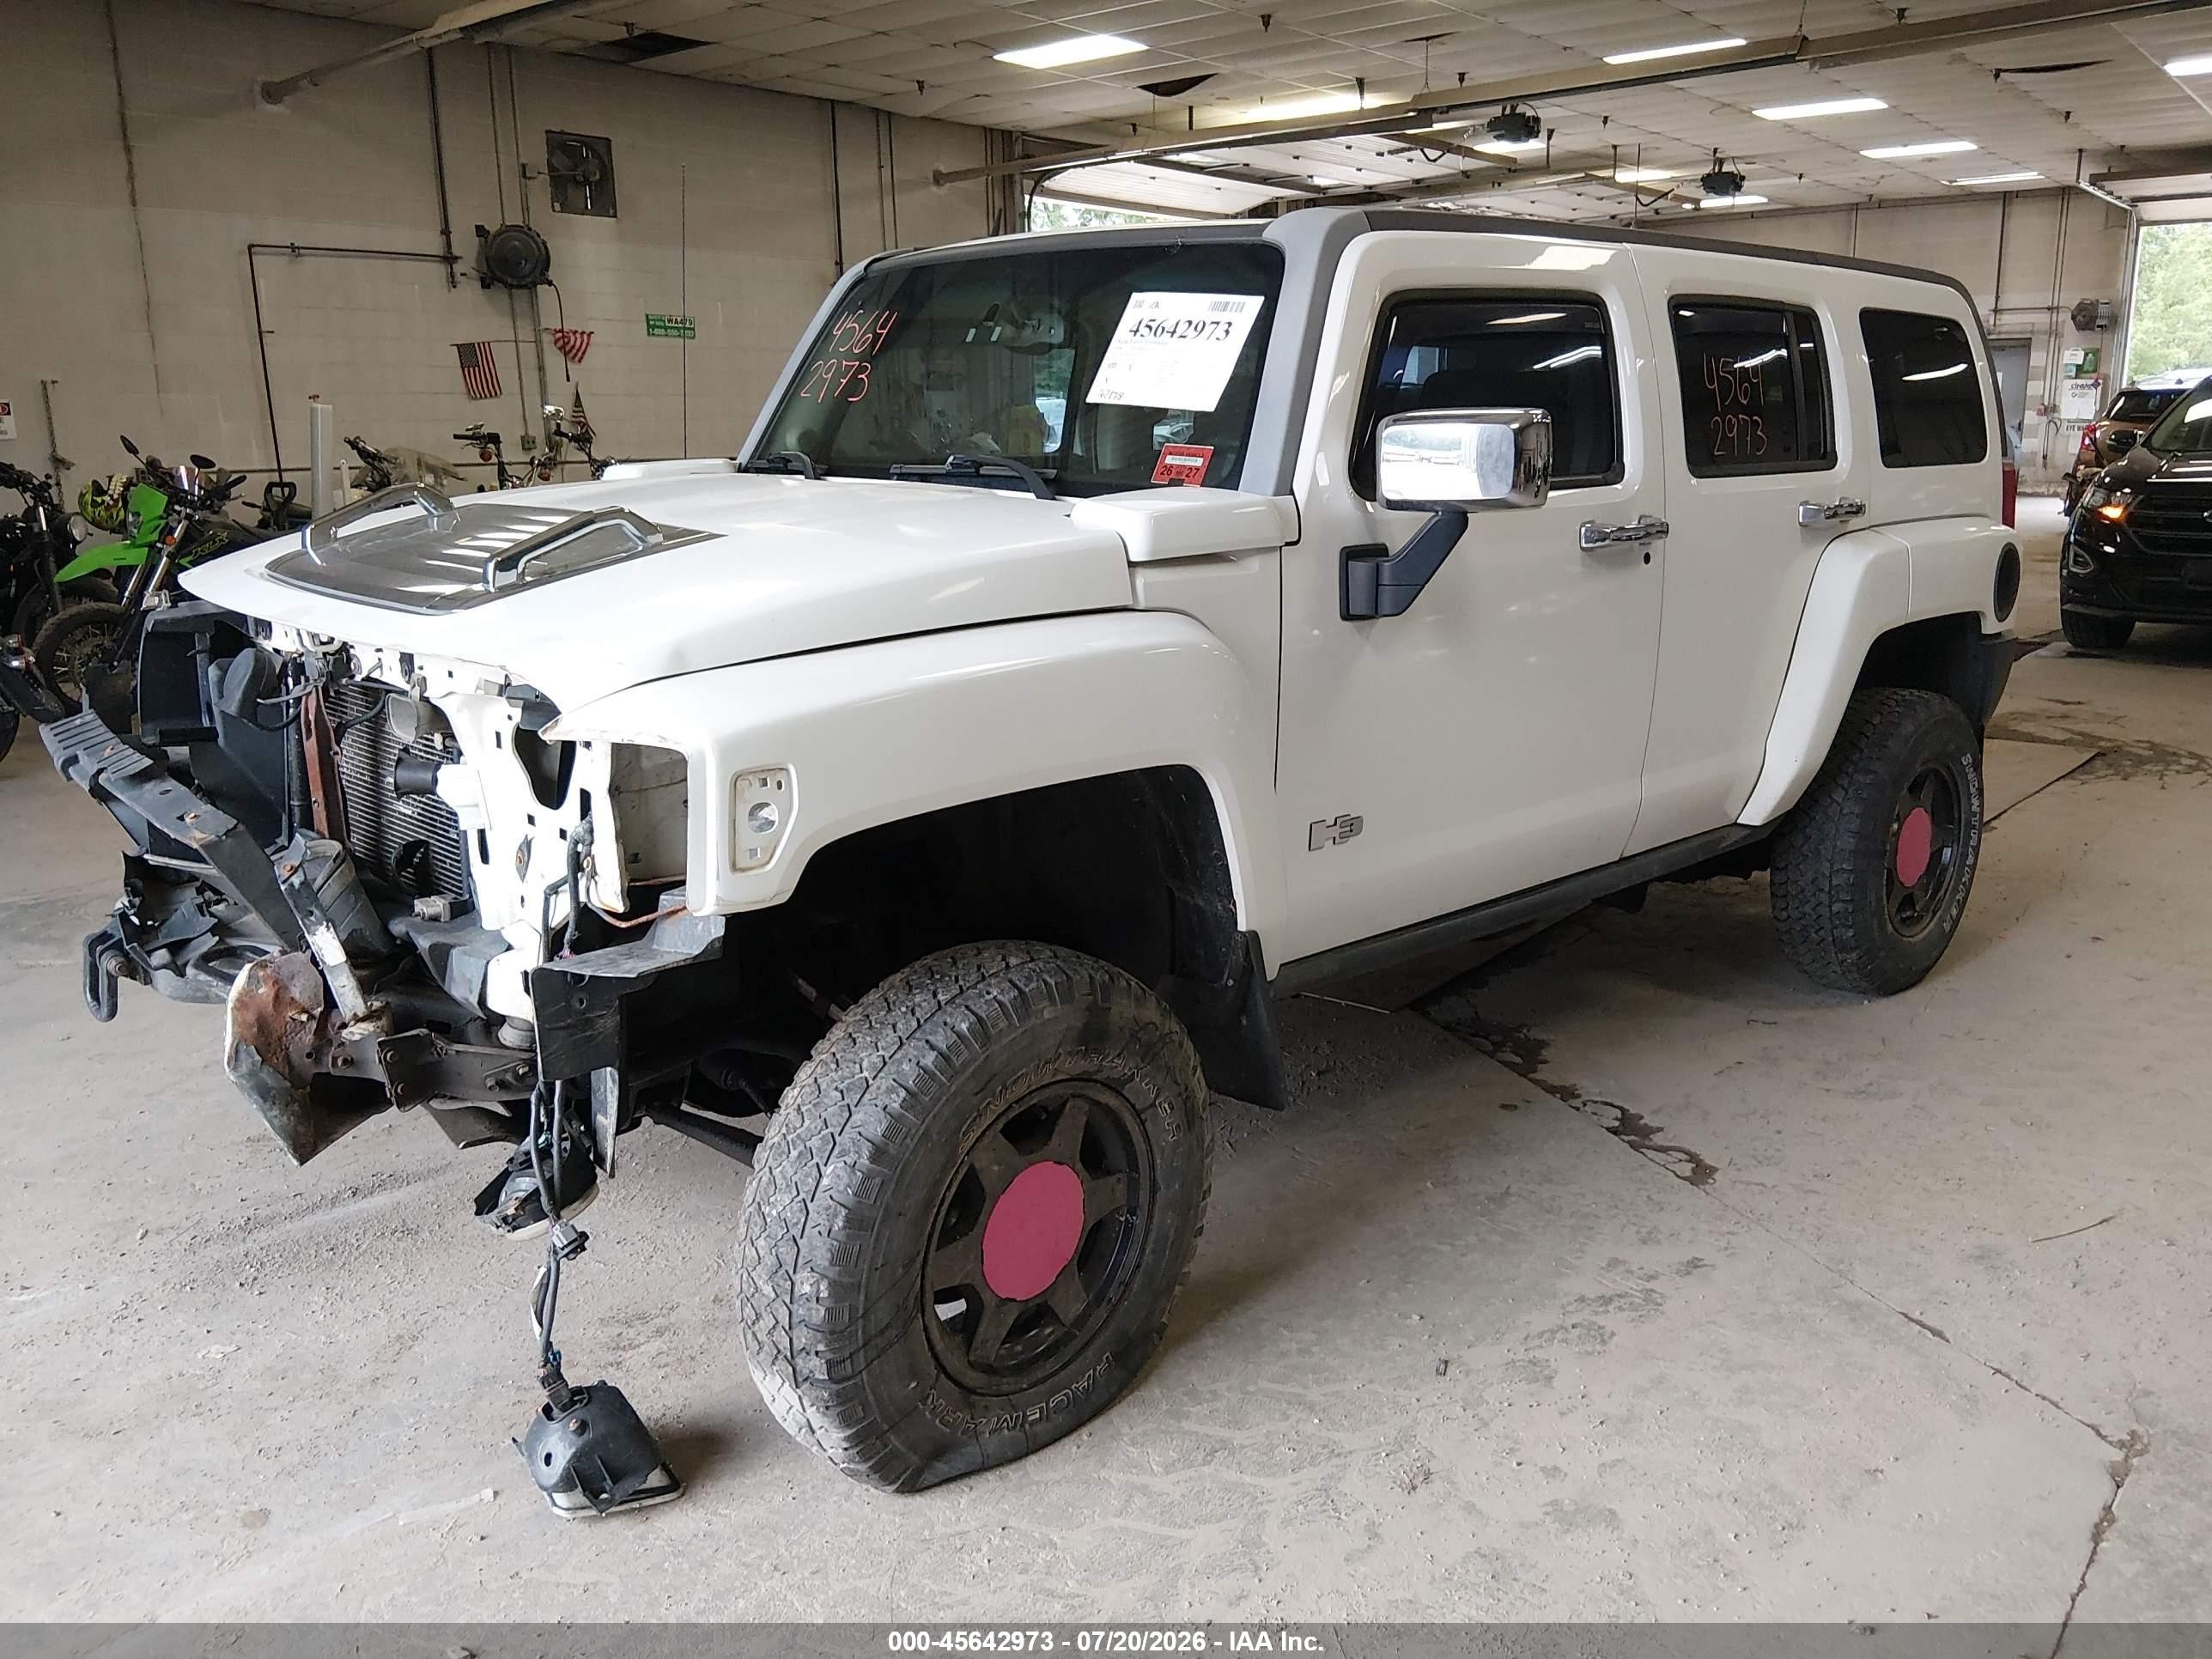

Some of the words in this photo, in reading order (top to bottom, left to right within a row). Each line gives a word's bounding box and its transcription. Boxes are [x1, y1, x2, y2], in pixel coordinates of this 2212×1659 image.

[829, 306, 898, 356] 4564
[1129, 318, 1233, 341] 45642973
[800, 359, 872, 404] 2973
[1704, 352, 1765, 412] 4564
[1711, 414, 1768, 457] 2973
[1160, 465, 1174, 476] 26
[1185, 467, 1200, 478] 27
[1308, 813, 1364, 852] H3
